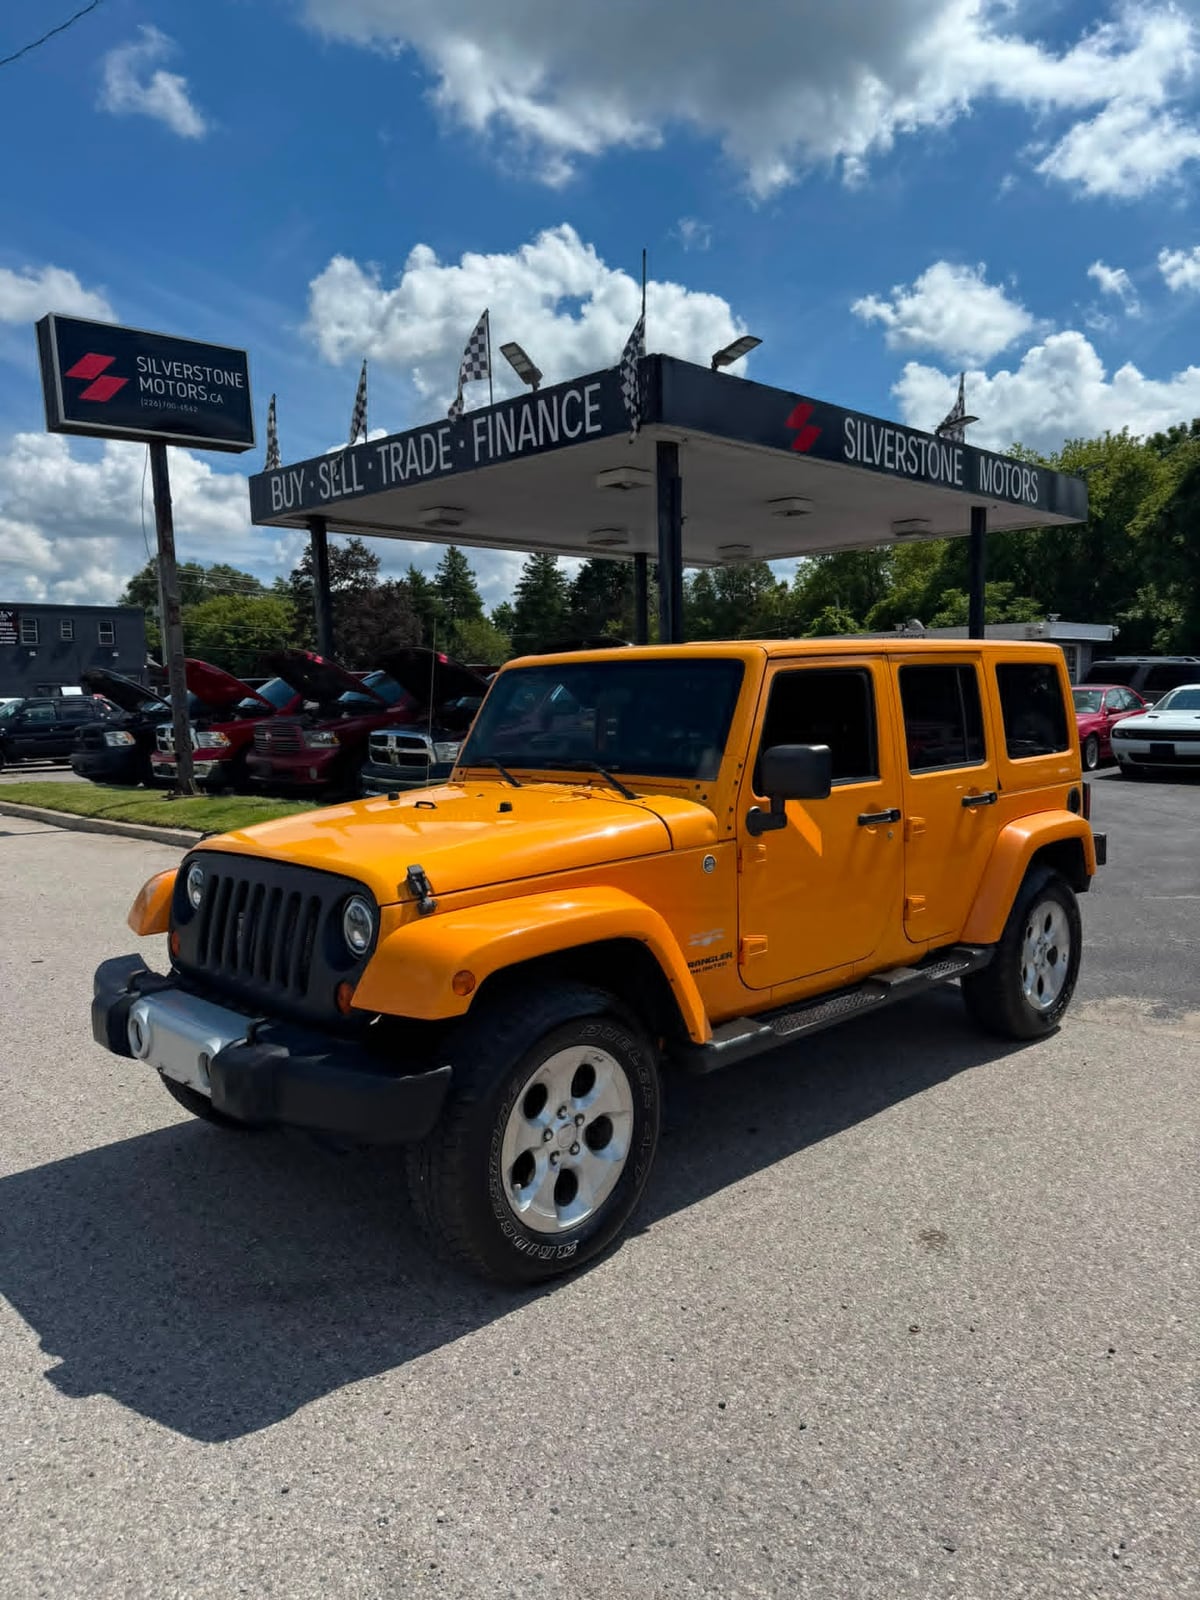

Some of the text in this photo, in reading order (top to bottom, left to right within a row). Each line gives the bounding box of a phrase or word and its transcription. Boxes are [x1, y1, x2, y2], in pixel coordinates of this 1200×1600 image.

[137, 356, 244, 389] SILVERSTONE
[270, 383, 603, 512] BUY SELL TRADE FINANCE
[844, 417, 1039, 504] SILVERSTONE MOTORS
[688, 952, 732, 968] RANGLER
